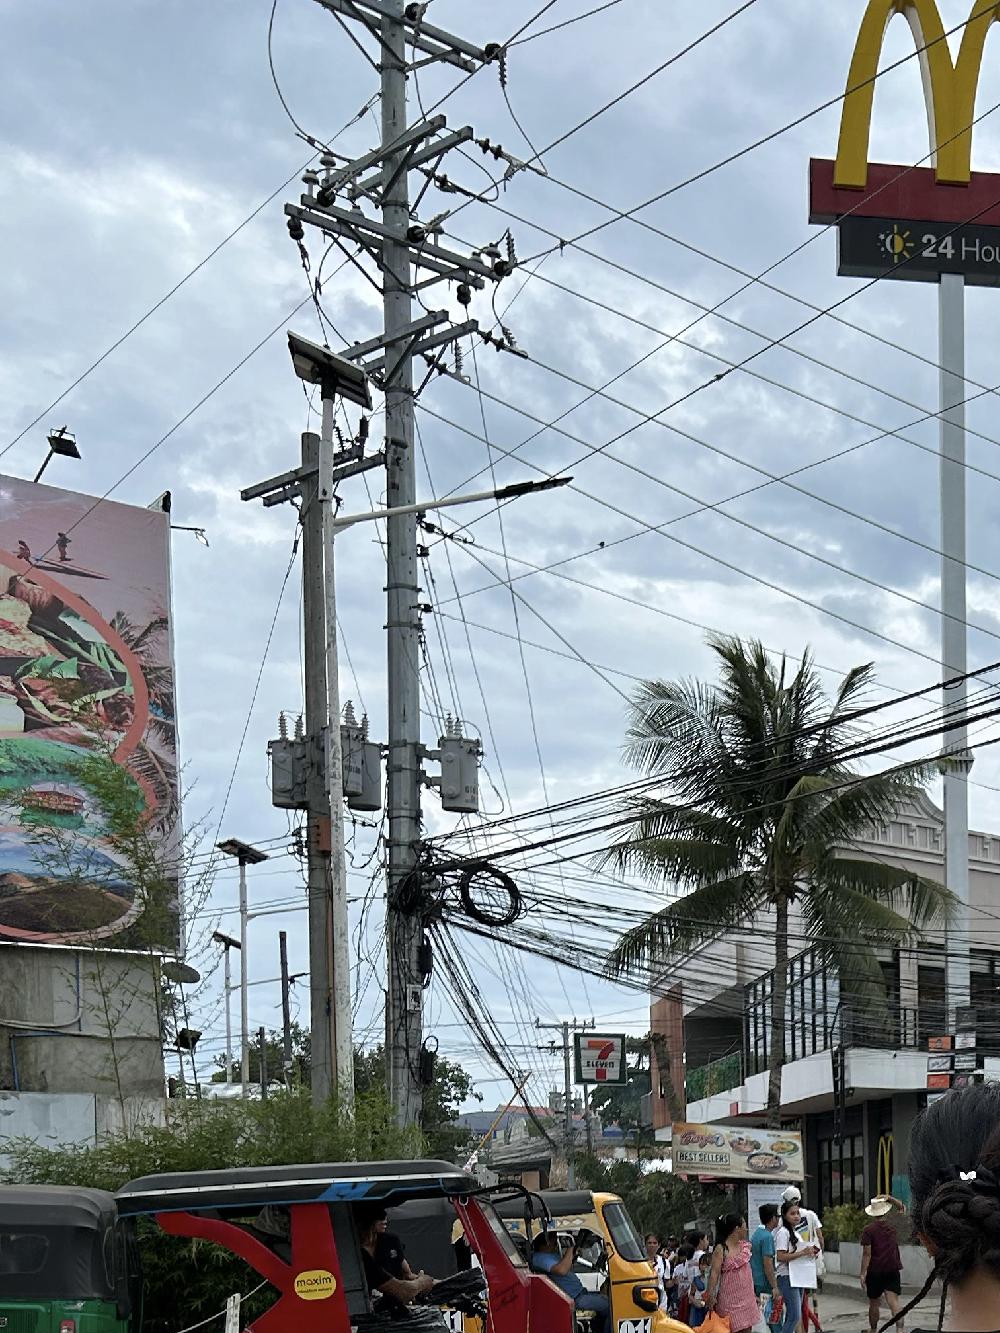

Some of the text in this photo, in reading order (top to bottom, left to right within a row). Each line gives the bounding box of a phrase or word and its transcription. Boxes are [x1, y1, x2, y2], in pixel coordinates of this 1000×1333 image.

[921, 233, 955, 260] 24
[587, 1039, 615, 1081] 7
[679, 1151, 729, 1164] BEST SELLERS
[296, 1275, 332, 1287] maxim
